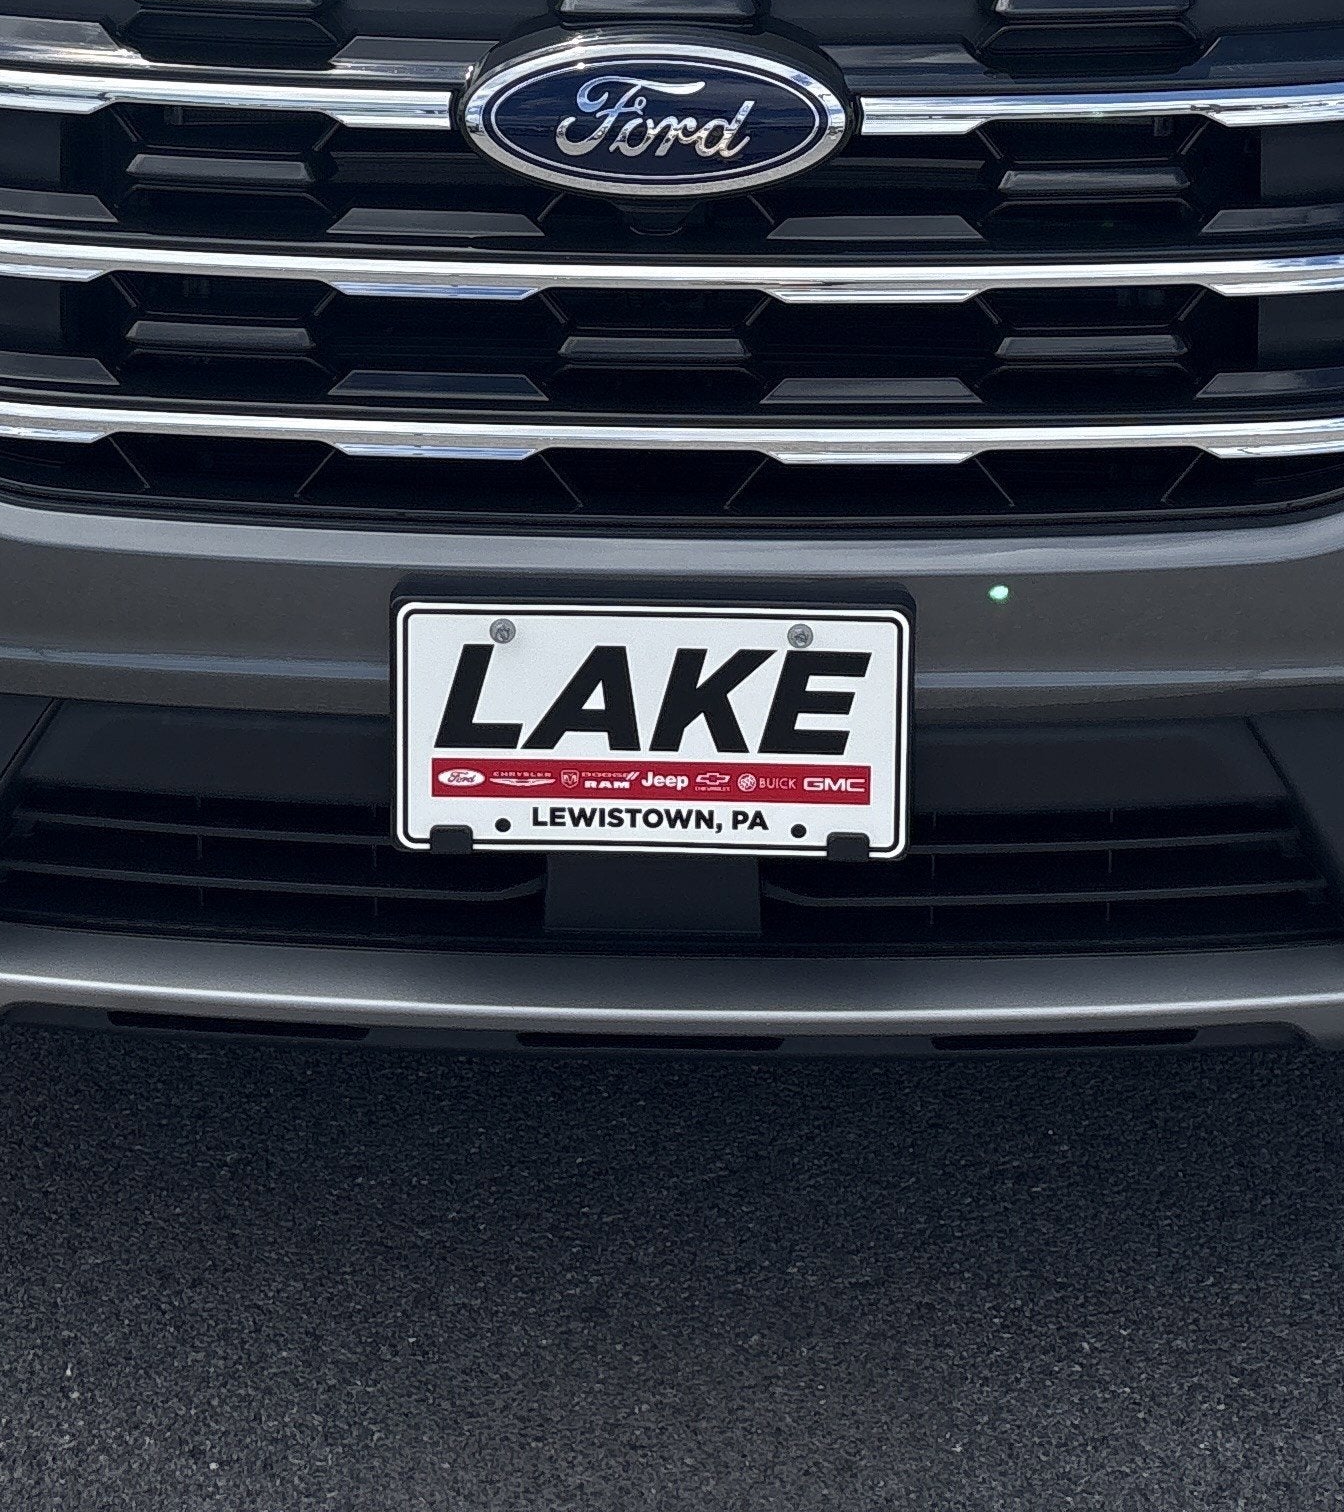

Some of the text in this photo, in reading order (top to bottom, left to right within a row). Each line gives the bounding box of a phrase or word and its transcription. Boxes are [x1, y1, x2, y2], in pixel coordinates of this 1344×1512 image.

[555, 75, 755, 157] Ford
[434, 644, 872, 754] LAKE
[584, 780, 630, 789] RAM
[641, 771, 689, 791] Jeep
[759, 777, 797, 790] BUICK
[803, 777, 866, 793] GMC
[532, 806, 769, 834] LEWISTOWN, PA
